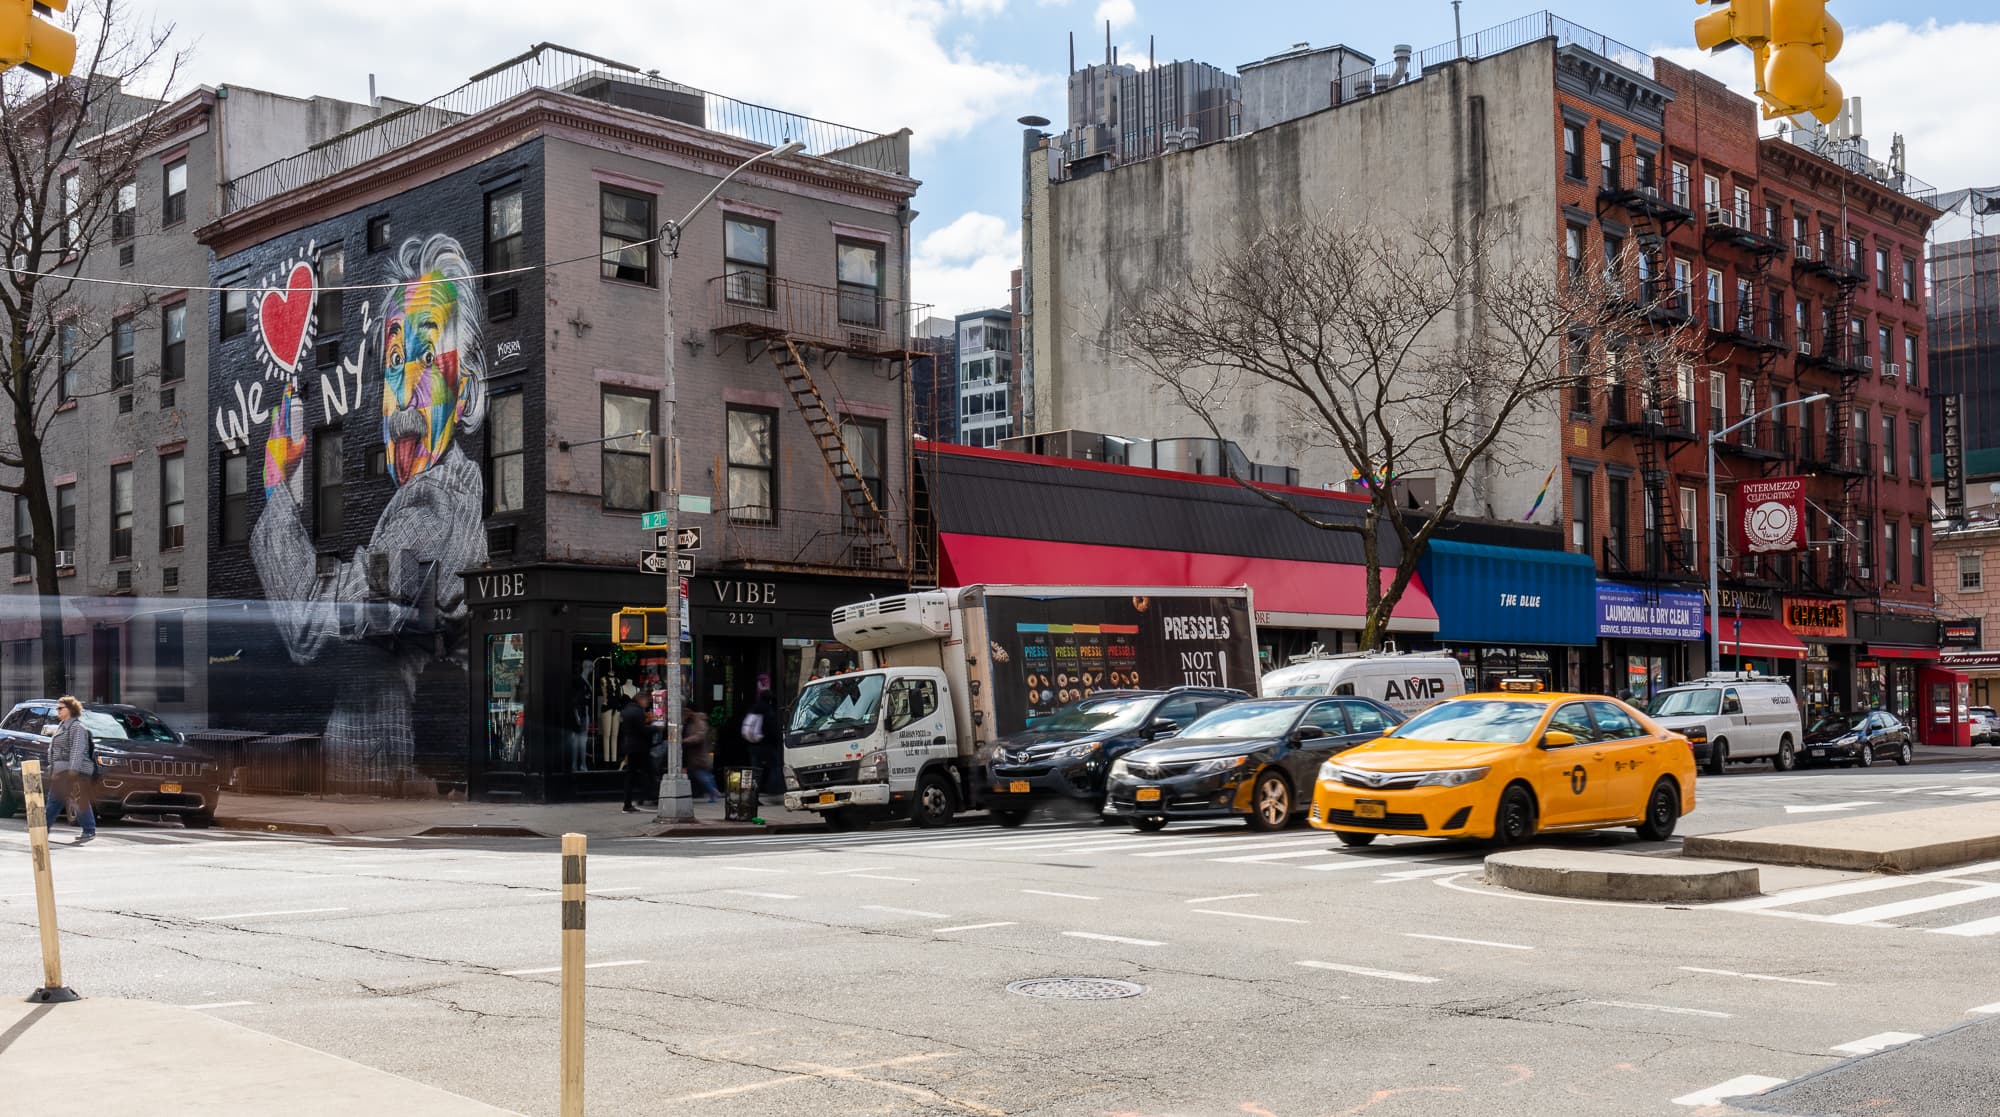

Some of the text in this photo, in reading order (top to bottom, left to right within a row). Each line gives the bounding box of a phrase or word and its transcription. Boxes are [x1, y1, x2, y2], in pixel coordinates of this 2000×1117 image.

[215, 379, 269, 455] We
[1743, 480, 1800, 494] INTERMEZZO
[643, 514, 650, 528] W
[1757, 508, 1788, 531] 20
[679, 534, 694, 545] WAY
[649, 557, 688, 569] ONE AY
[477, 573, 525, 599] VIBE
[713, 580, 777, 604] VIBE
[1500, 593, 1541, 608] THE BLUE
[492, 607, 512, 621] 212
[729, 612, 755, 625] 212
[1605, 604, 1690, 625] LAUNDROMAT & DRY CLEAN
[1163, 616, 1230, 640] PRESSELS
[1621, 625, 1632, 634] SELF
[1651, 627, 1662, 636] FREE
[1662, 628, 1678, 637] PICKUP
[1682, 629, 1701, 638] DELIVERY
[1180, 650, 1214, 670] NOT
[1384, 676, 1445, 701] AMP
